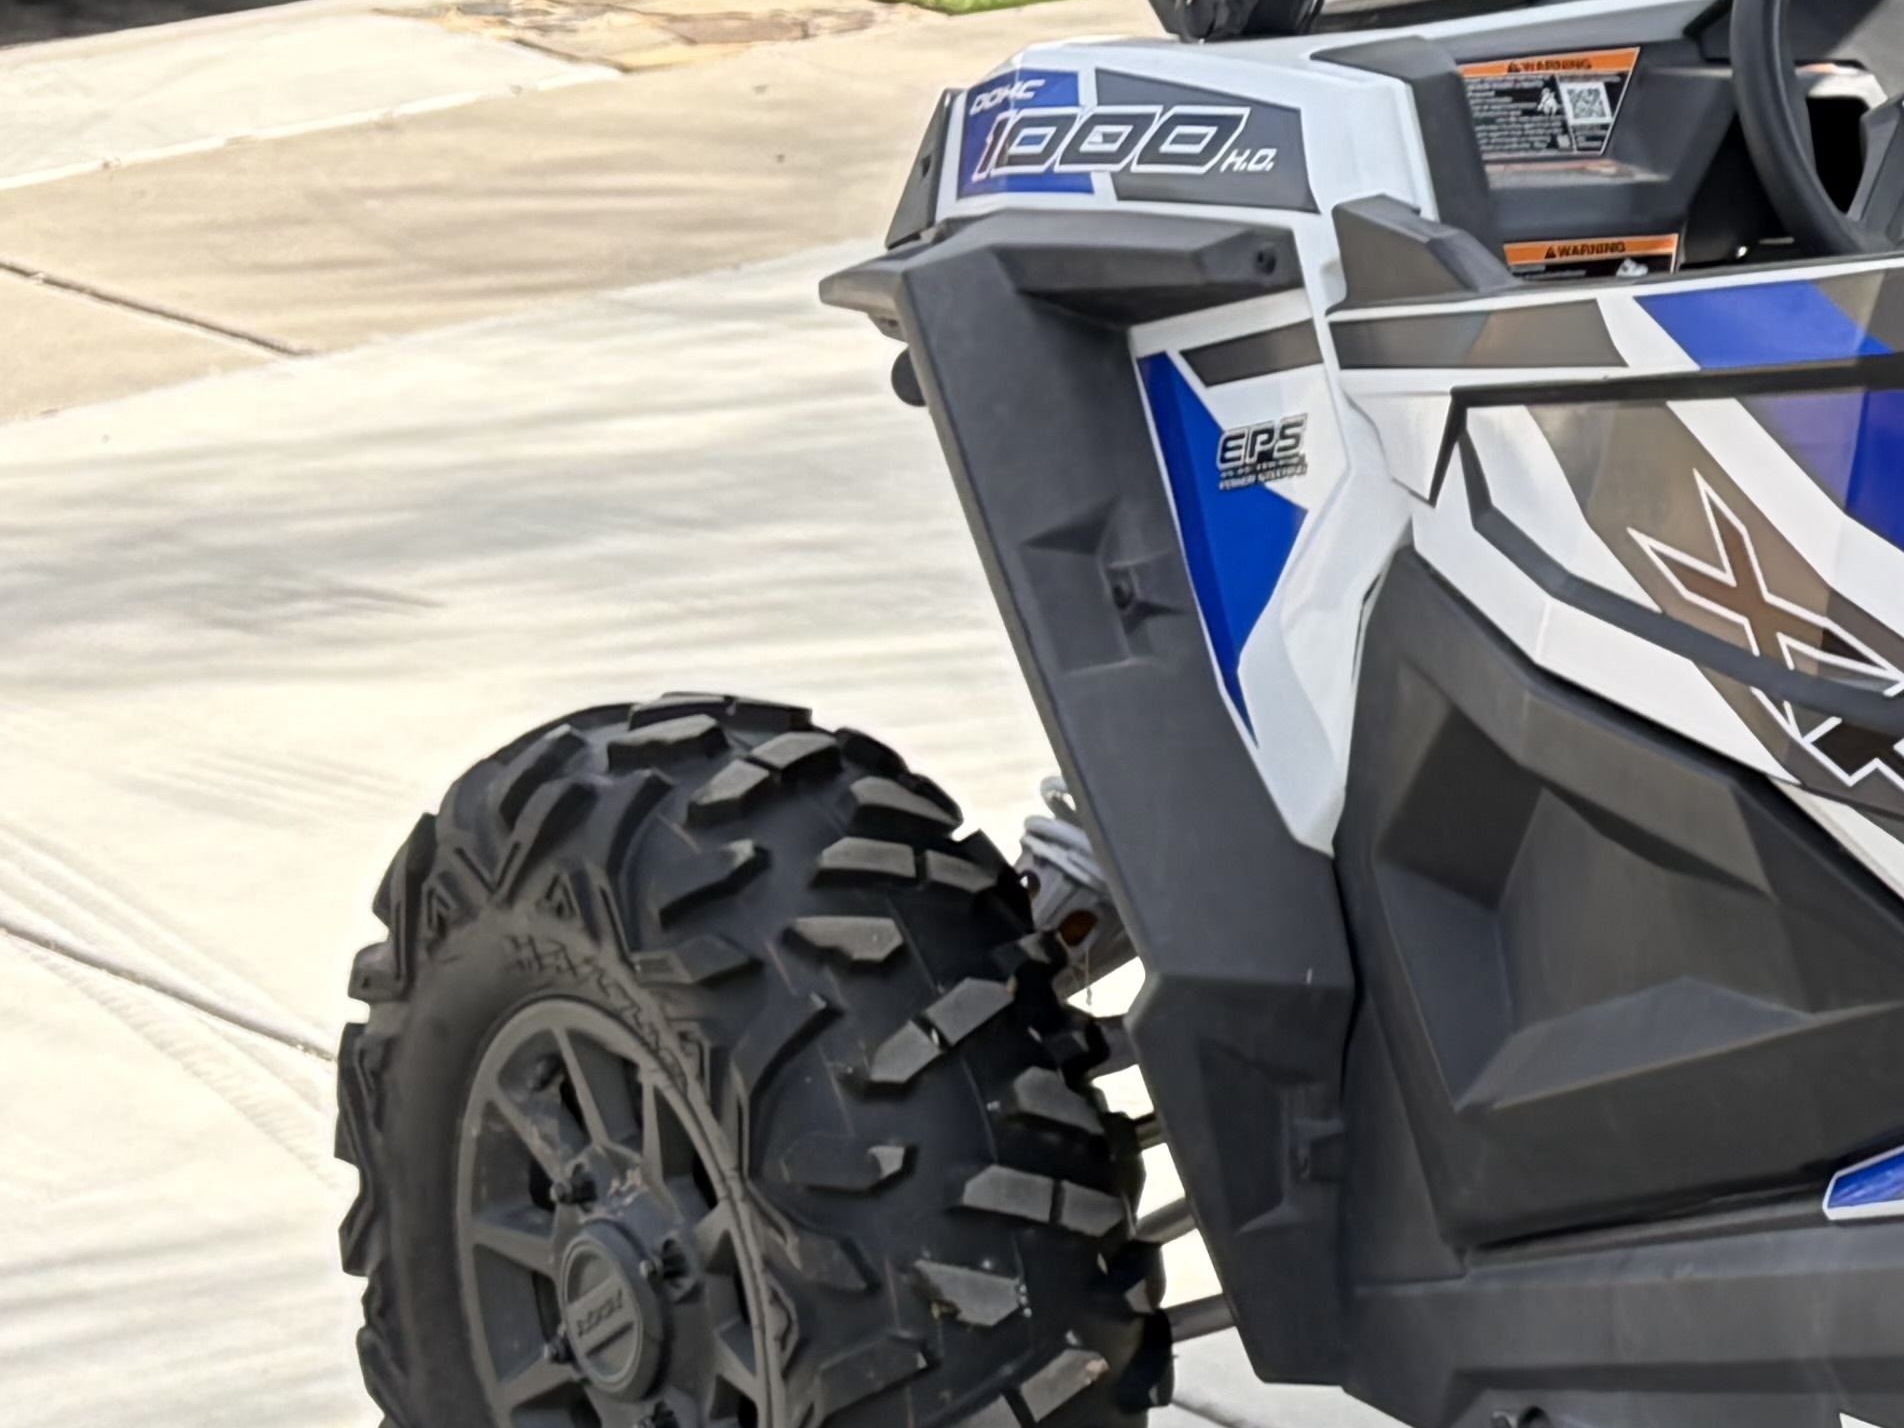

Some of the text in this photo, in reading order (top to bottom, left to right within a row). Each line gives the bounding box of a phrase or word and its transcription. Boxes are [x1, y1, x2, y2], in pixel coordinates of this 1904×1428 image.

[969, 78, 1046, 116] DOHC
[971, 104, 1251, 182] 1000
[1555, 241, 1627, 257] WARNING
[1216, 413, 1308, 471] EPS
